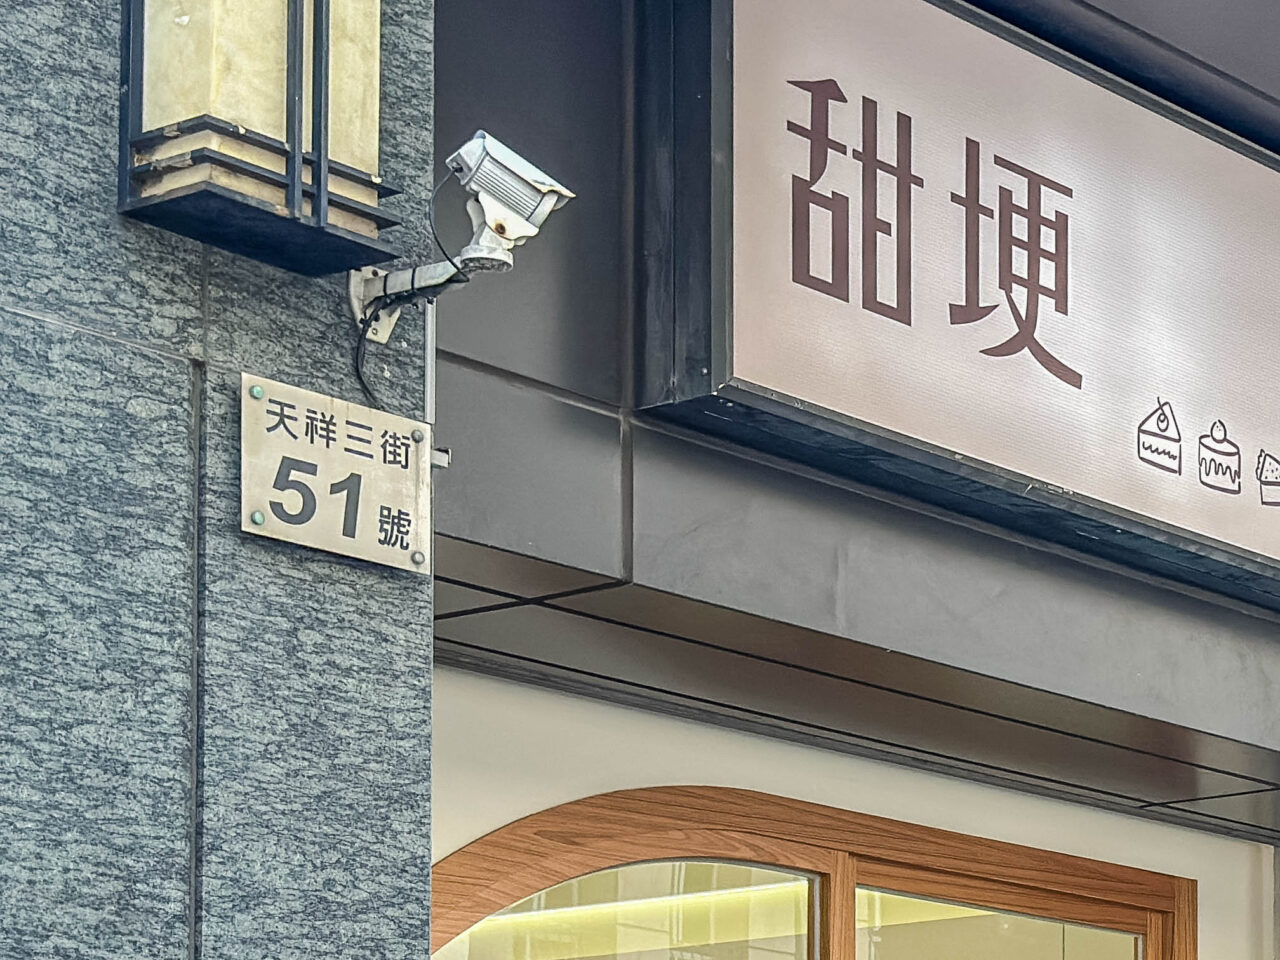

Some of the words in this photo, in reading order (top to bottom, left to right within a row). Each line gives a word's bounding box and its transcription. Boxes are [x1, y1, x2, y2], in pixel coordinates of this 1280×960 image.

[787, 78, 1083, 390] 甜埂
[266, 398, 412, 470] 天祥三街
